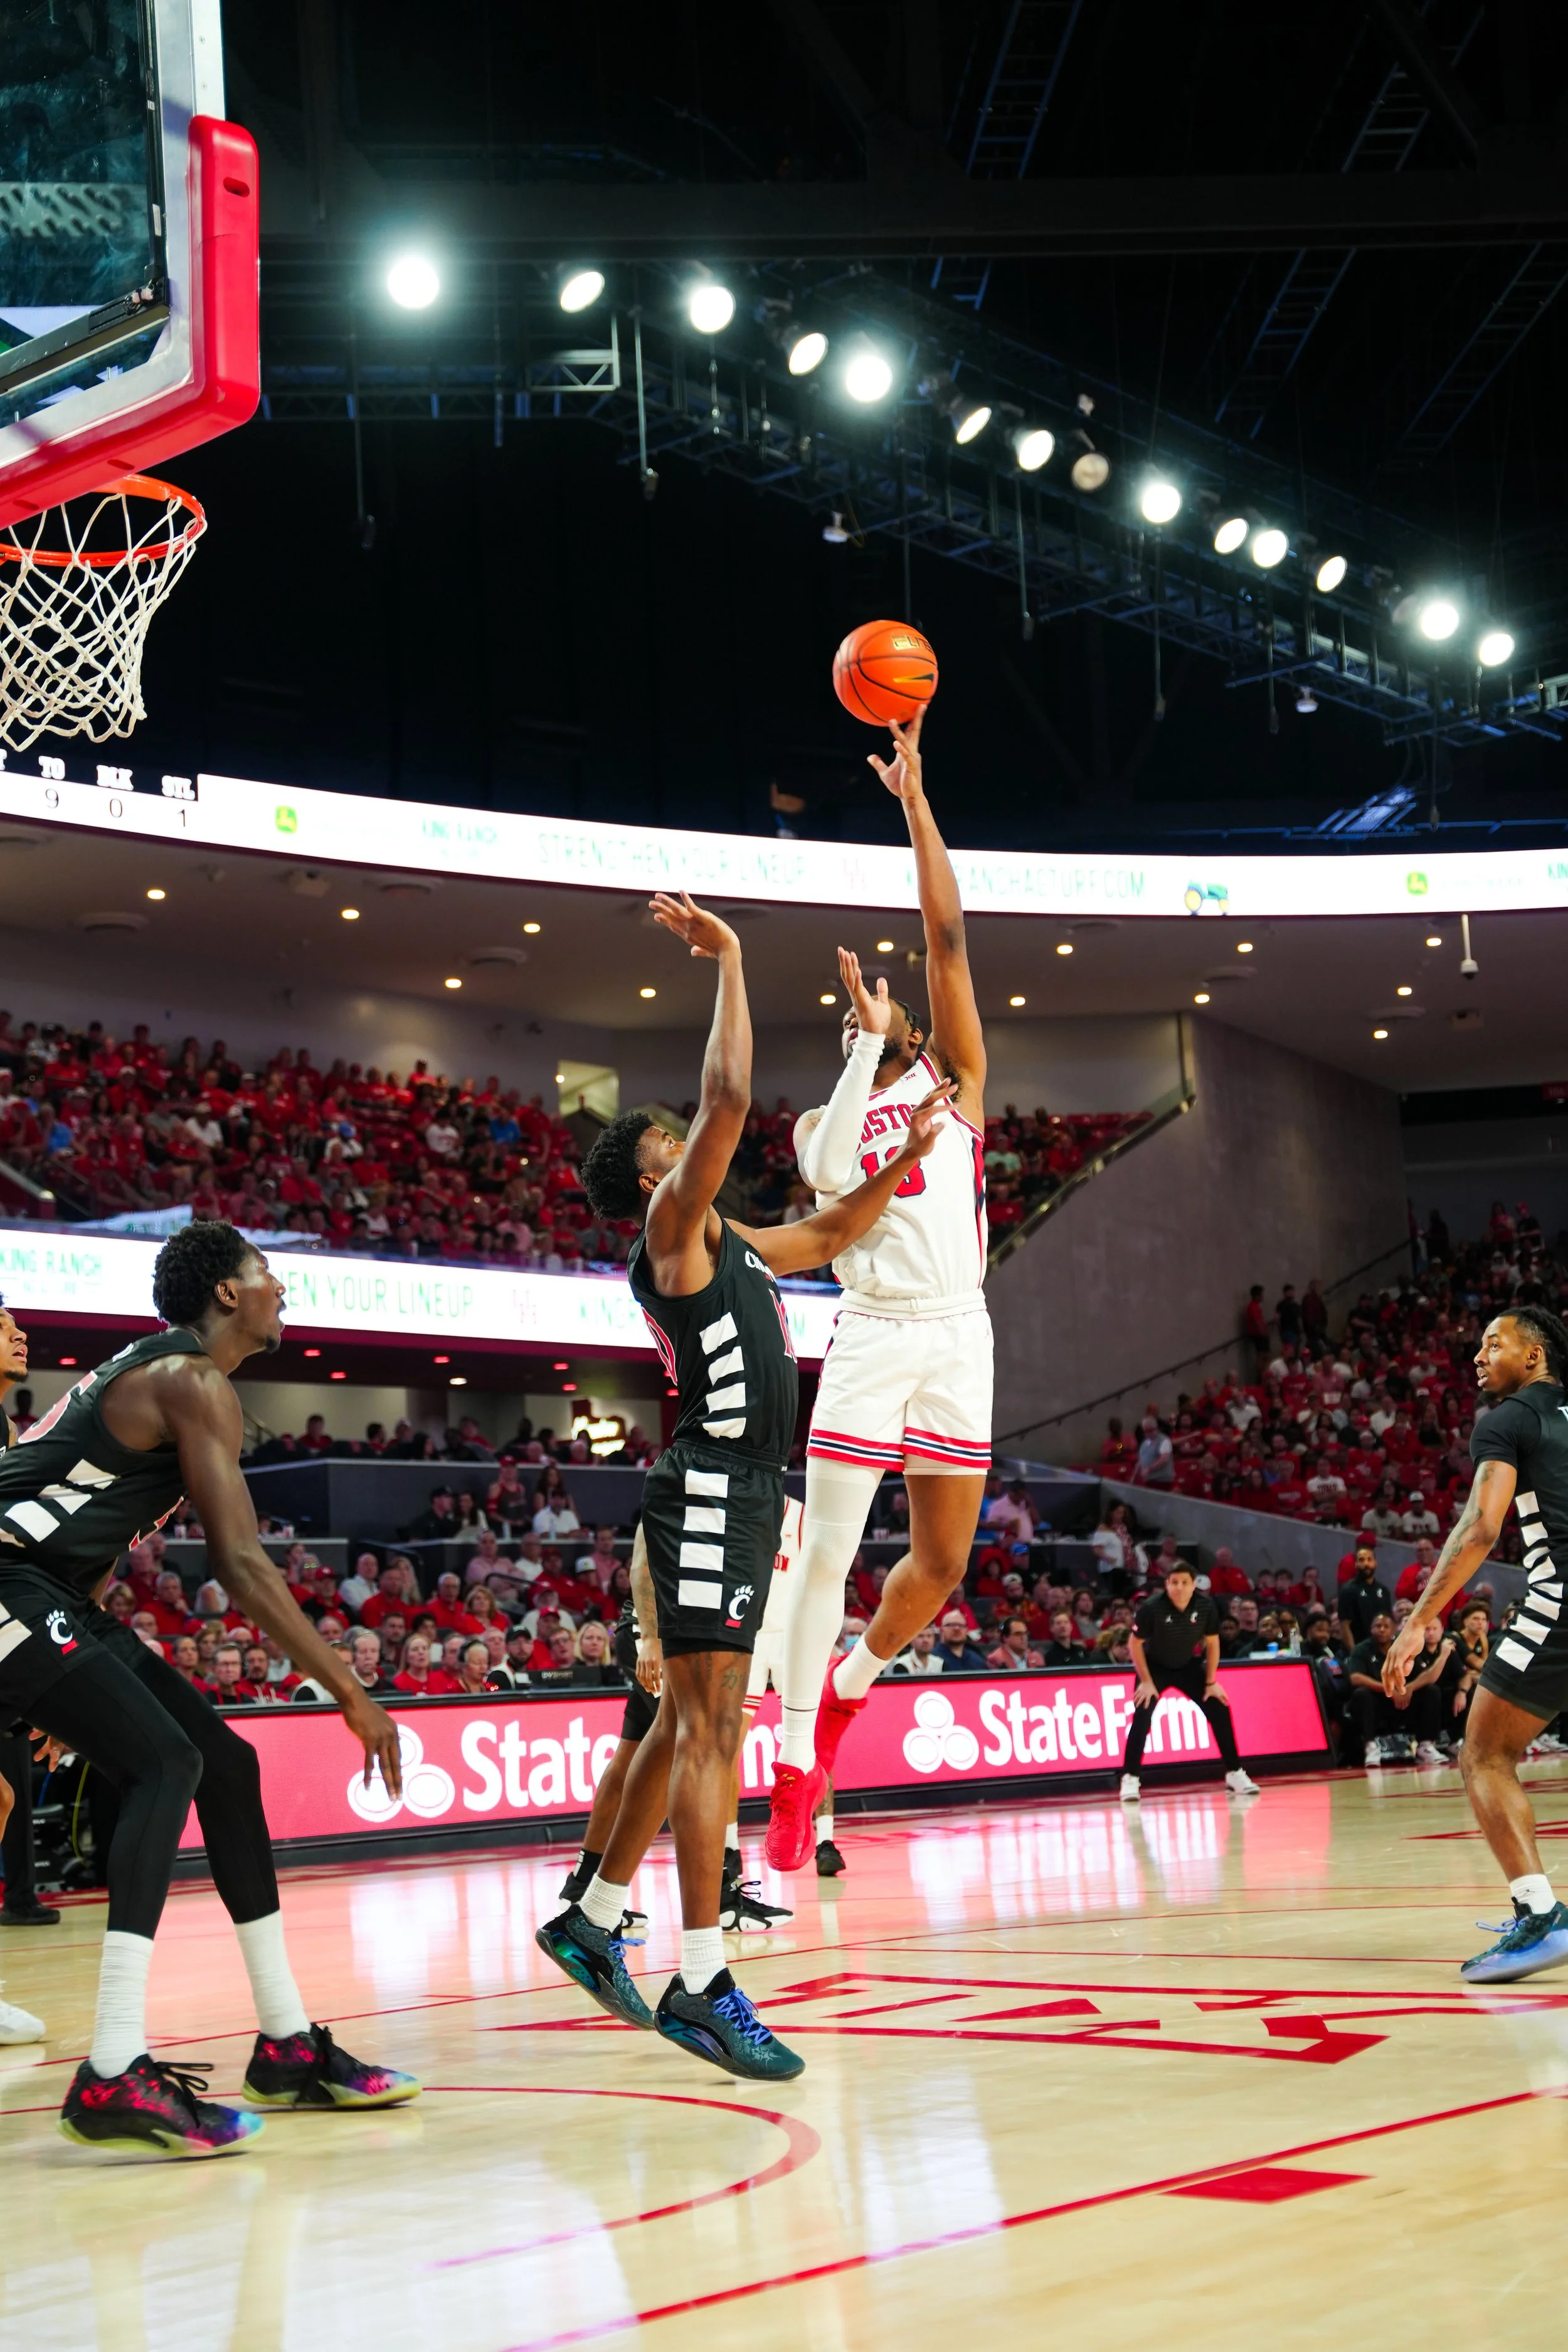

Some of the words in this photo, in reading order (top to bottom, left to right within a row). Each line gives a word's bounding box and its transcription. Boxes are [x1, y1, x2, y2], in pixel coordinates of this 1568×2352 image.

[38, 755, 65, 780] TO
[162, 775, 195, 800] STL
[45, 788, 60, 808] 9
[109, 798, 123, 818] 0
[177, 808, 186, 828] 1
[327, 1275, 388, 1313] YOUR
[398, 1281, 474, 1317] LINEUP
